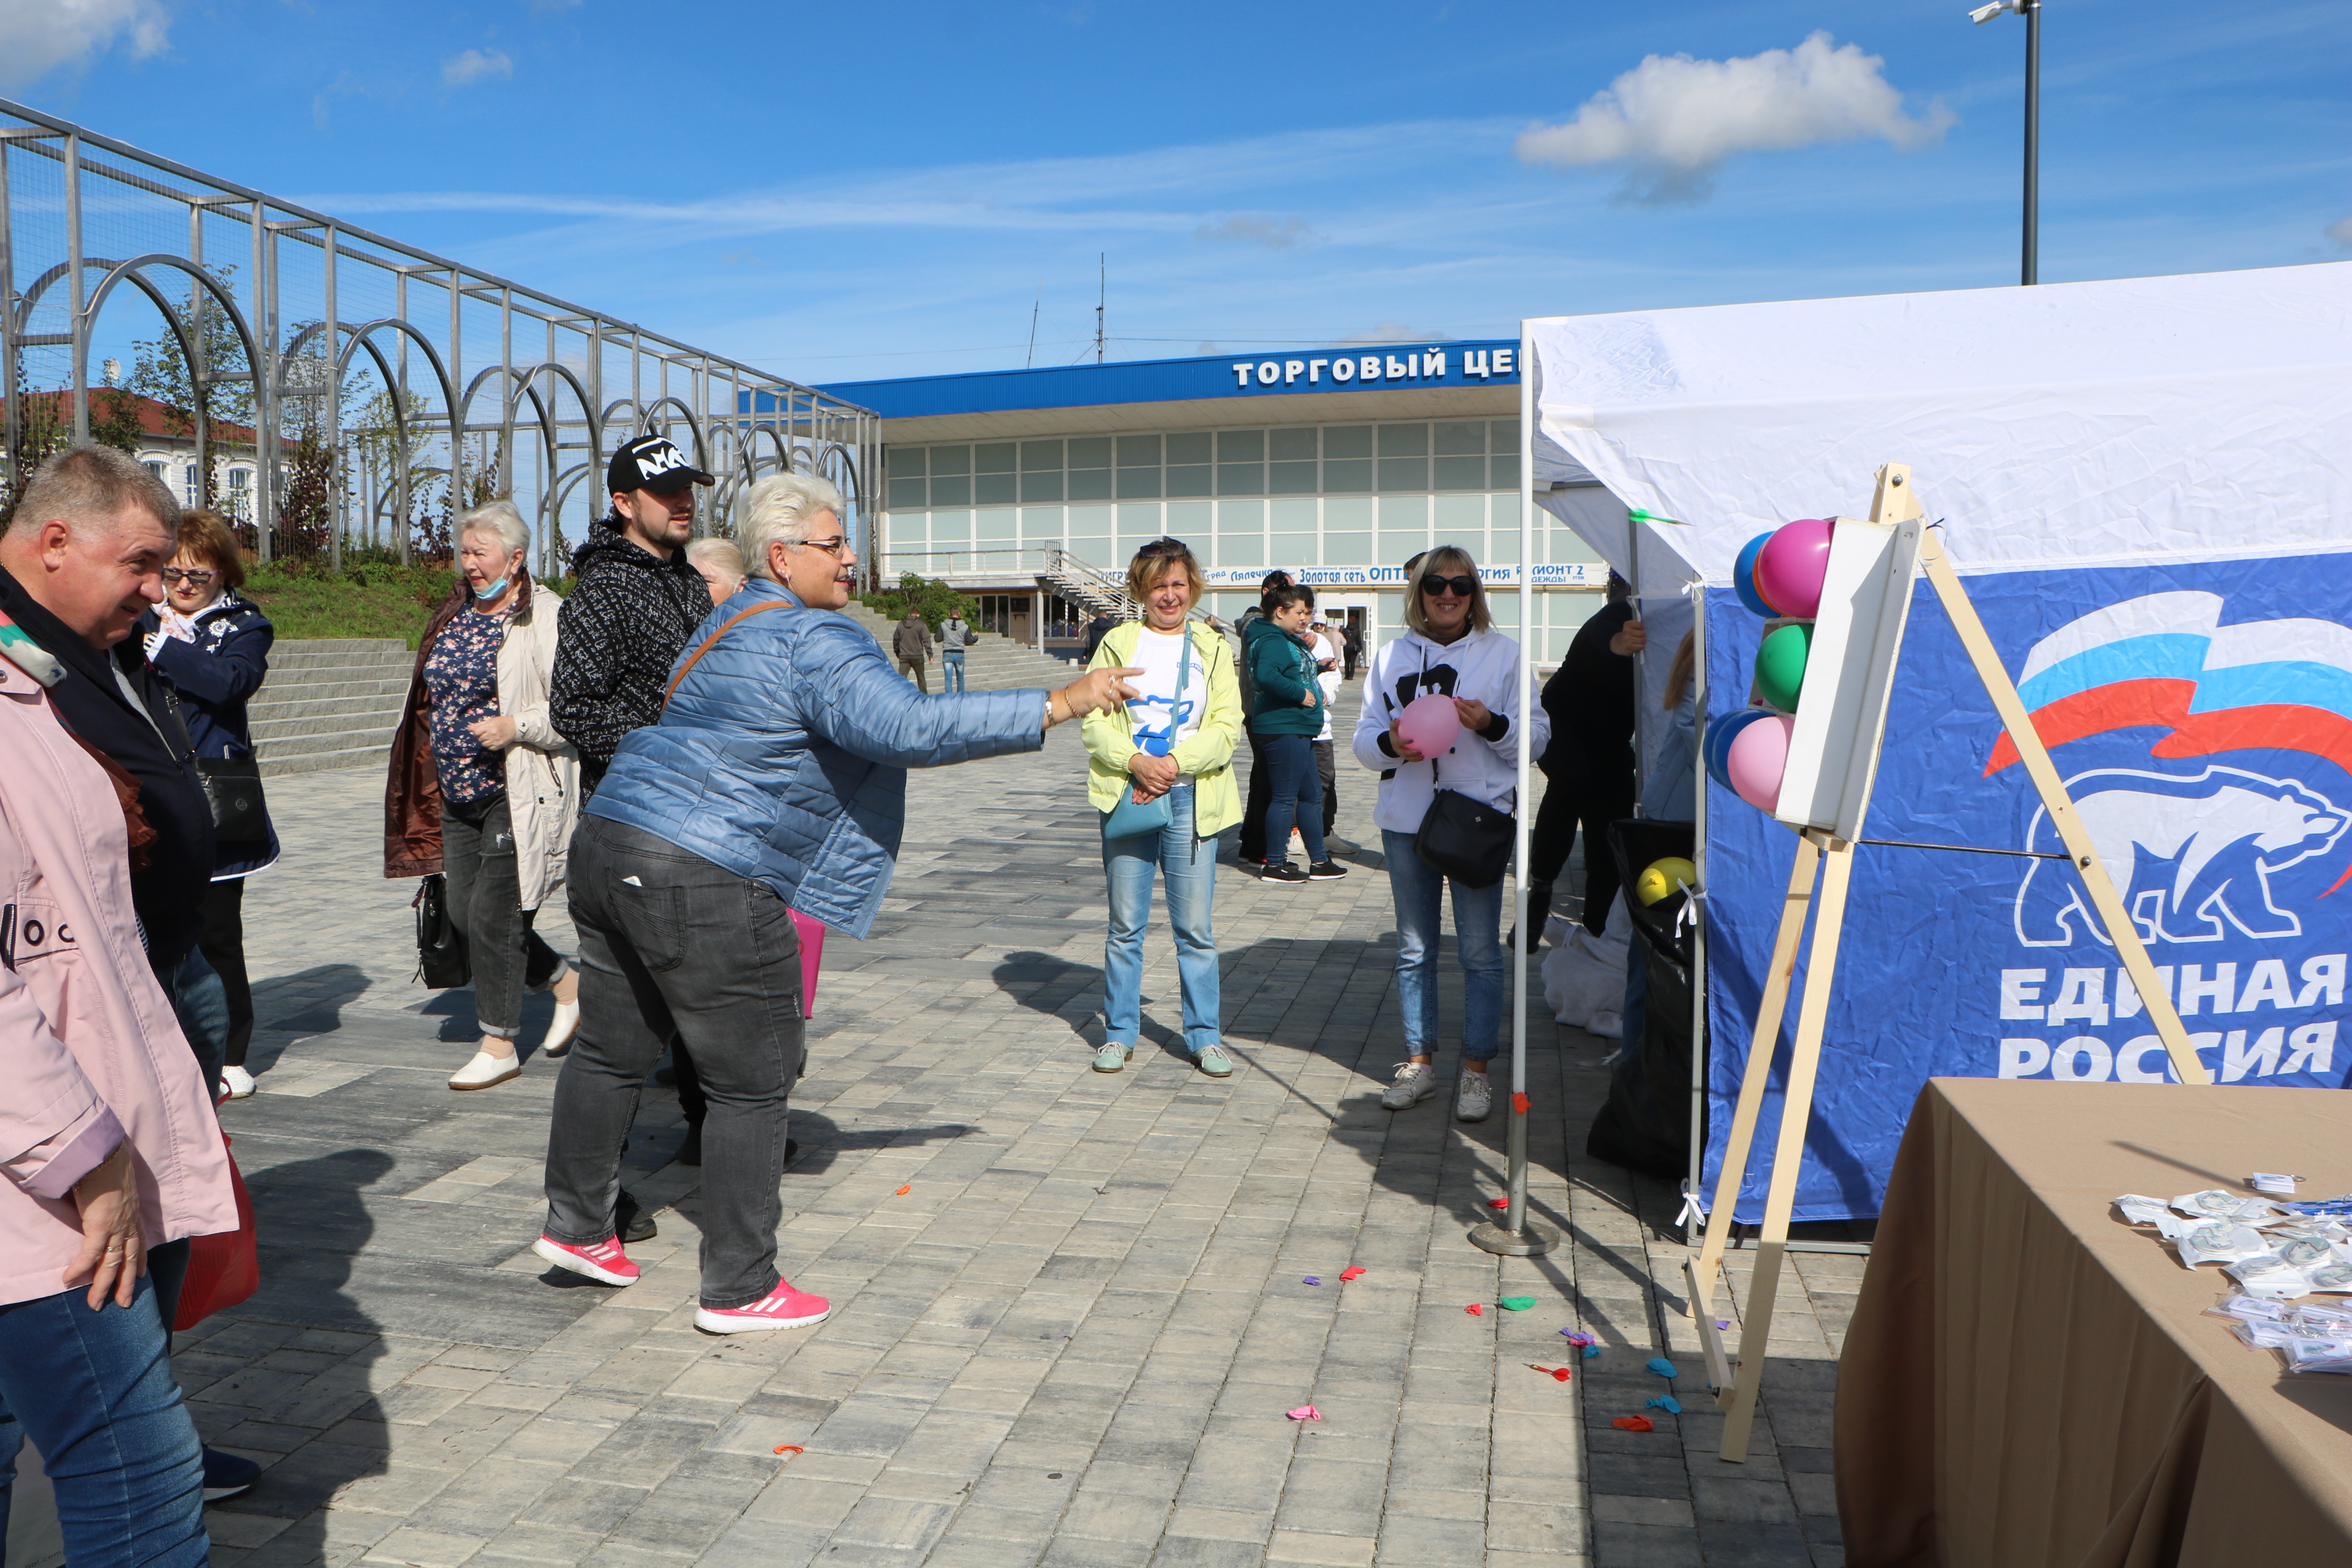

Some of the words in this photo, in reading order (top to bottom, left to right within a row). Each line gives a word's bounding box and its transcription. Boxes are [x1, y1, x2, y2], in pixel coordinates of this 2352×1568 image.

[1233, 347, 1446, 386] ТОРГОВЫЙ
[1464, 348, 1521, 379] ЦЕ
[1299, 568, 1341, 584] Золотая
[1344, 572, 1366, 583] сеть
[1516, 565, 1573, 575] РМОНТ
[1577, 565, 1583, 575] 2
[2000, 953, 2347, 1026] ЕДИНАЯ
